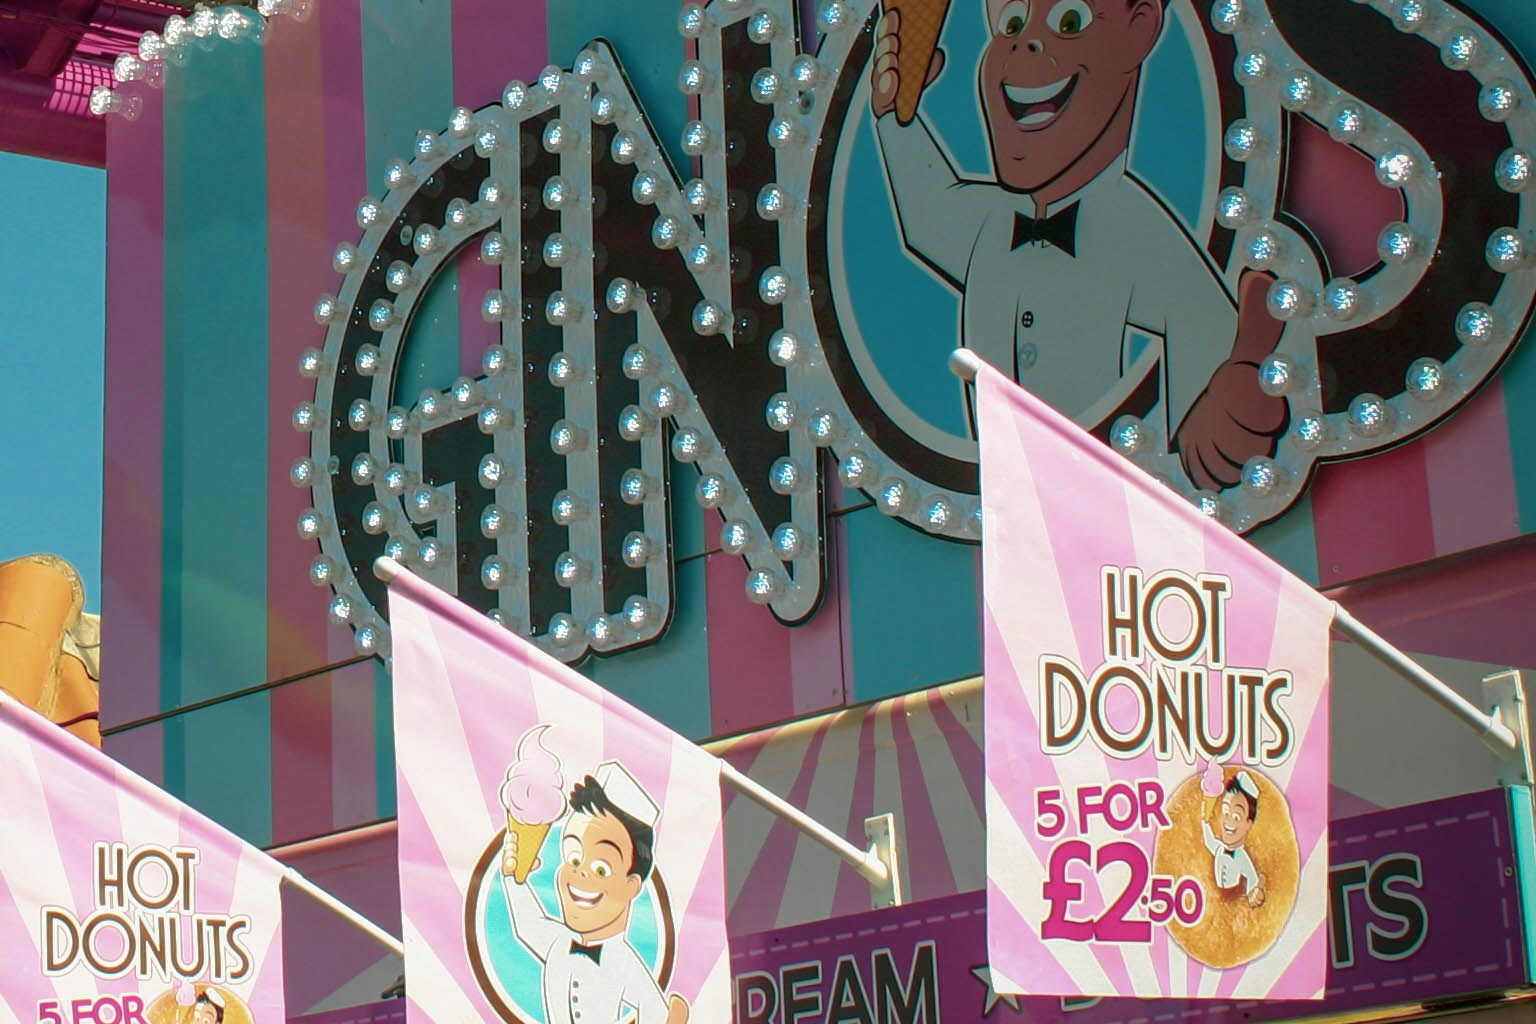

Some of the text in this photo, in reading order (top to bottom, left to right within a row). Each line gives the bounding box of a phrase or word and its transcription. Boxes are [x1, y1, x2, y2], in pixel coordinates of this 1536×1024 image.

[1104, 569, 1230, 666] HOT
[1042, 659, 1292, 762] DONUTS
[1035, 780, 1171, 838] 5 FOR
[96, 844, 197, 913] HOT
[45, 908, 251, 980] DONUTS
[730, 938, 942, 1024] REAM
